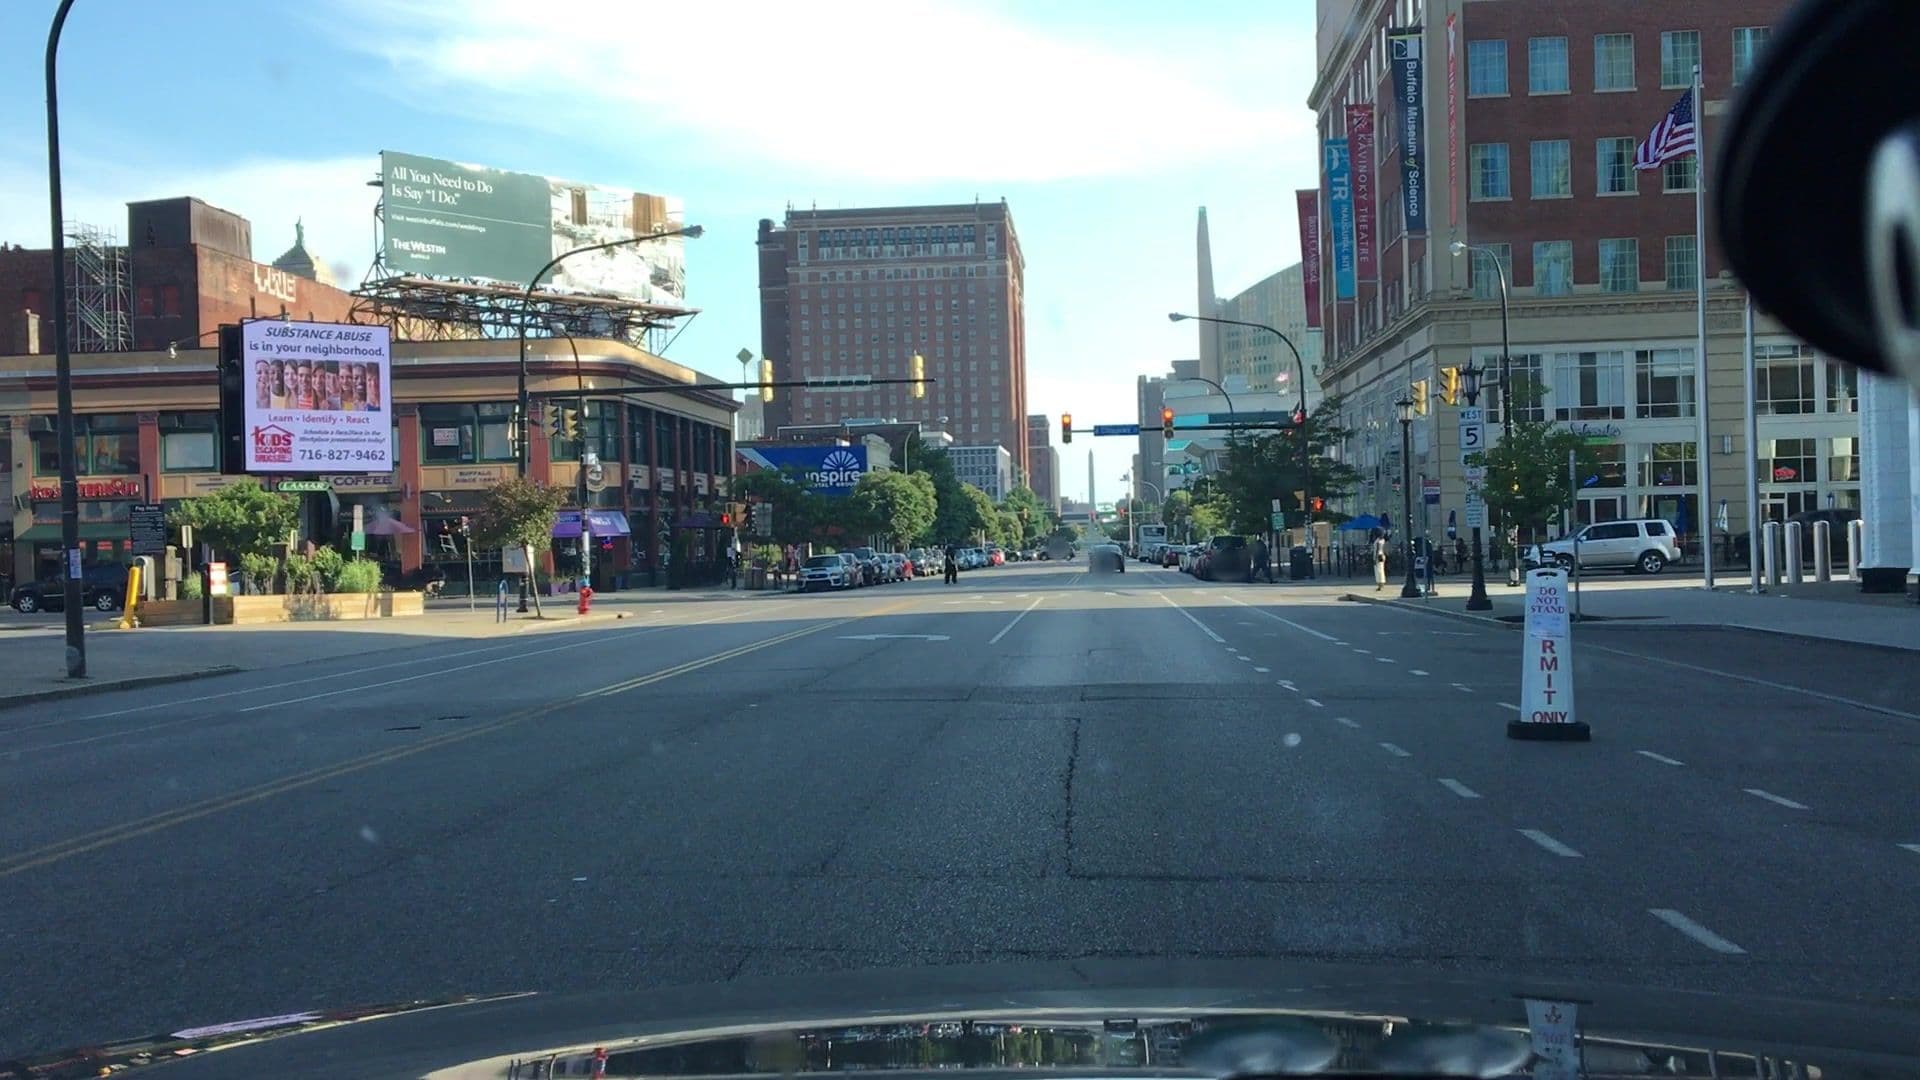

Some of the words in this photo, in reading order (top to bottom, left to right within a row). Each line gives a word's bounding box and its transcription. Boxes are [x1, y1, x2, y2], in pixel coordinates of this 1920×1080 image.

[1406, 61, 1418, 104] Buffalo
[1407, 106, 1418, 156] Museum
[1358, 134, 1369, 201] KAVINOKY
[1404, 156, 1420, 170] of
[391, 166, 407, 181] All
[409, 168, 431, 184] You
[432, 171, 462, 189] Need
[463, 179, 476, 191] to
[476, 180, 493, 194] Do
[1331, 172, 1349, 200] TR
[391, 183, 402, 197] Is
[403, 185, 424, 204] Say
[1408, 170, 1420, 217] Science
[1359, 206, 1369, 263] THEATRE
[265, 326, 333, 340] SUBSTANCE
[334, 329, 373, 342] ABUSE
[249, 340, 259, 351] is
[262, 340, 273, 352] in
[276, 344, 302, 354] your
[305, 344, 385, 357] neighborhood.
[268, 414, 294, 423] Learn
[302, 414, 338, 425] Identify
[345, 416, 370, 424] React
[1460, 410, 1481, 419] WEST
[1465, 427, 1479, 446] 5
[299, 449, 386, 461] 716-827-9462
[333, 476, 393, 486] COFFEE
[1539, 586, 1557, 596] DO
[1536, 596, 1560, 605] NOT
[1530, 605, 1565, 614] STAND
